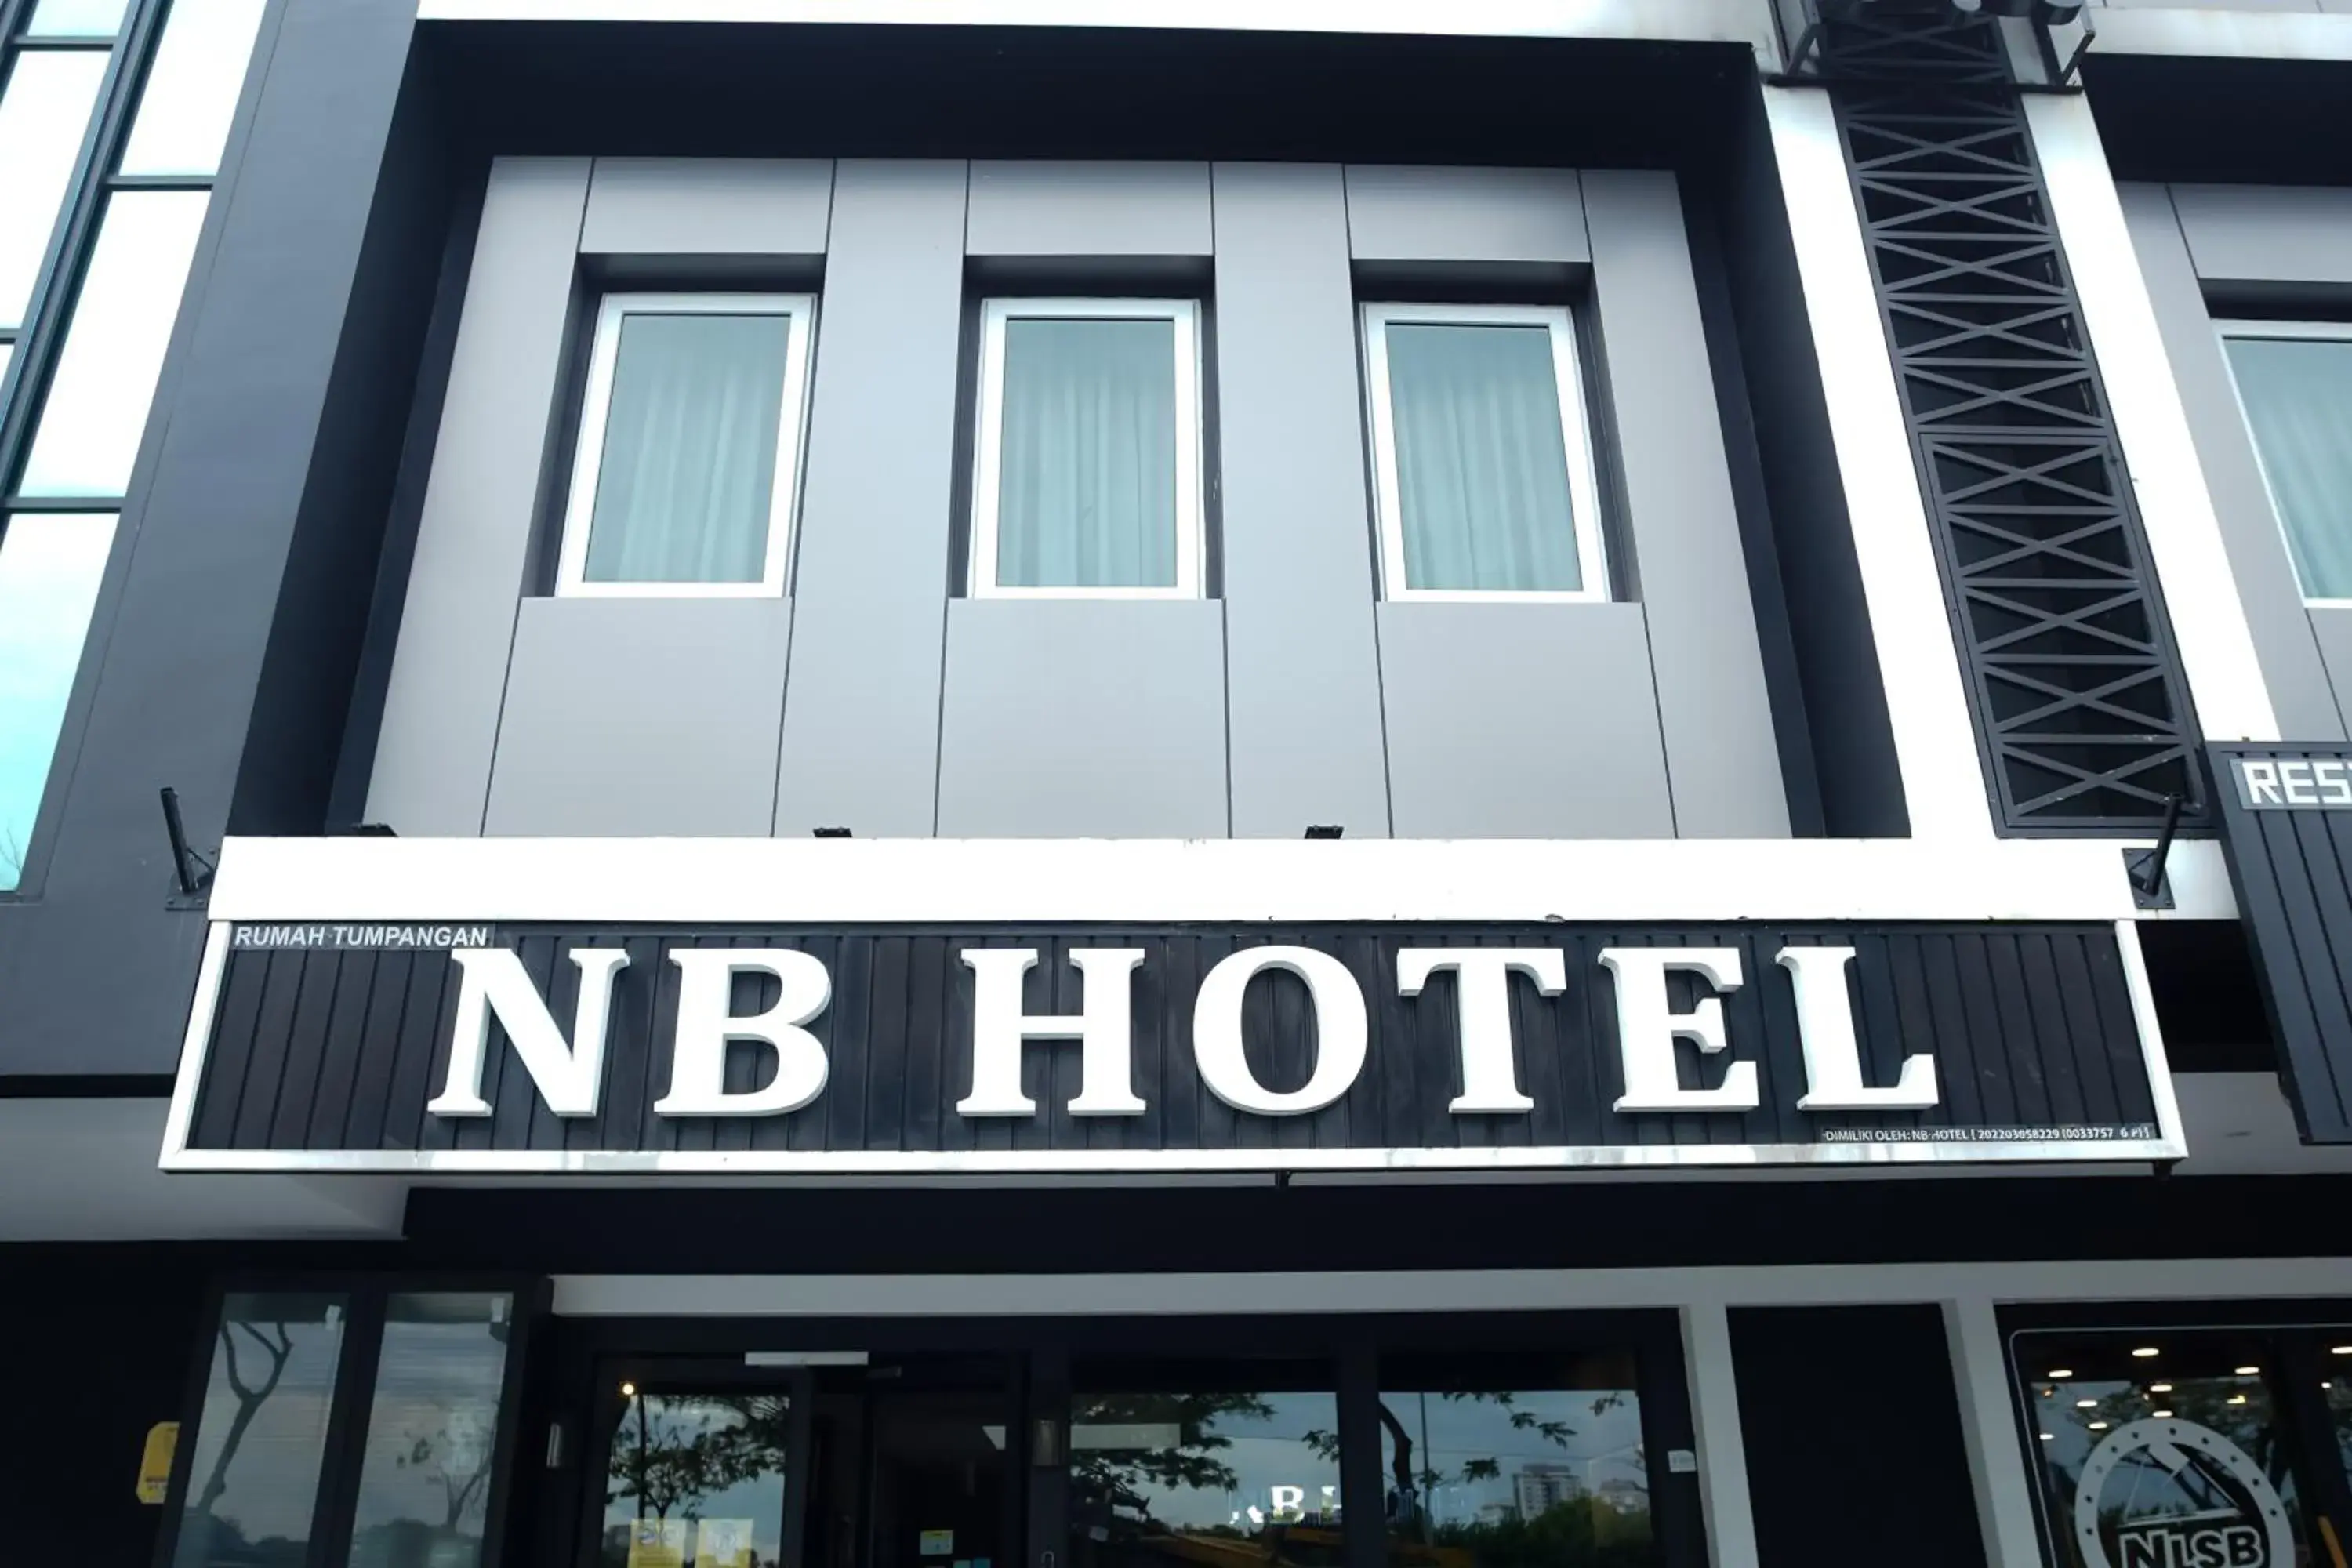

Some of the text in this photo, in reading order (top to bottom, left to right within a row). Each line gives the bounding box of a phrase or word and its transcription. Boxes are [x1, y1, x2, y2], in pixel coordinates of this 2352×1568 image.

[2242, 762, 2352, 804] RES
[234, 926, 488, 947] RUMAH TUMPANGAN
[426, 945, 1940, 1116] NB HOTEL
[1825, 1130, 1873, 1142] DIMILIKI
